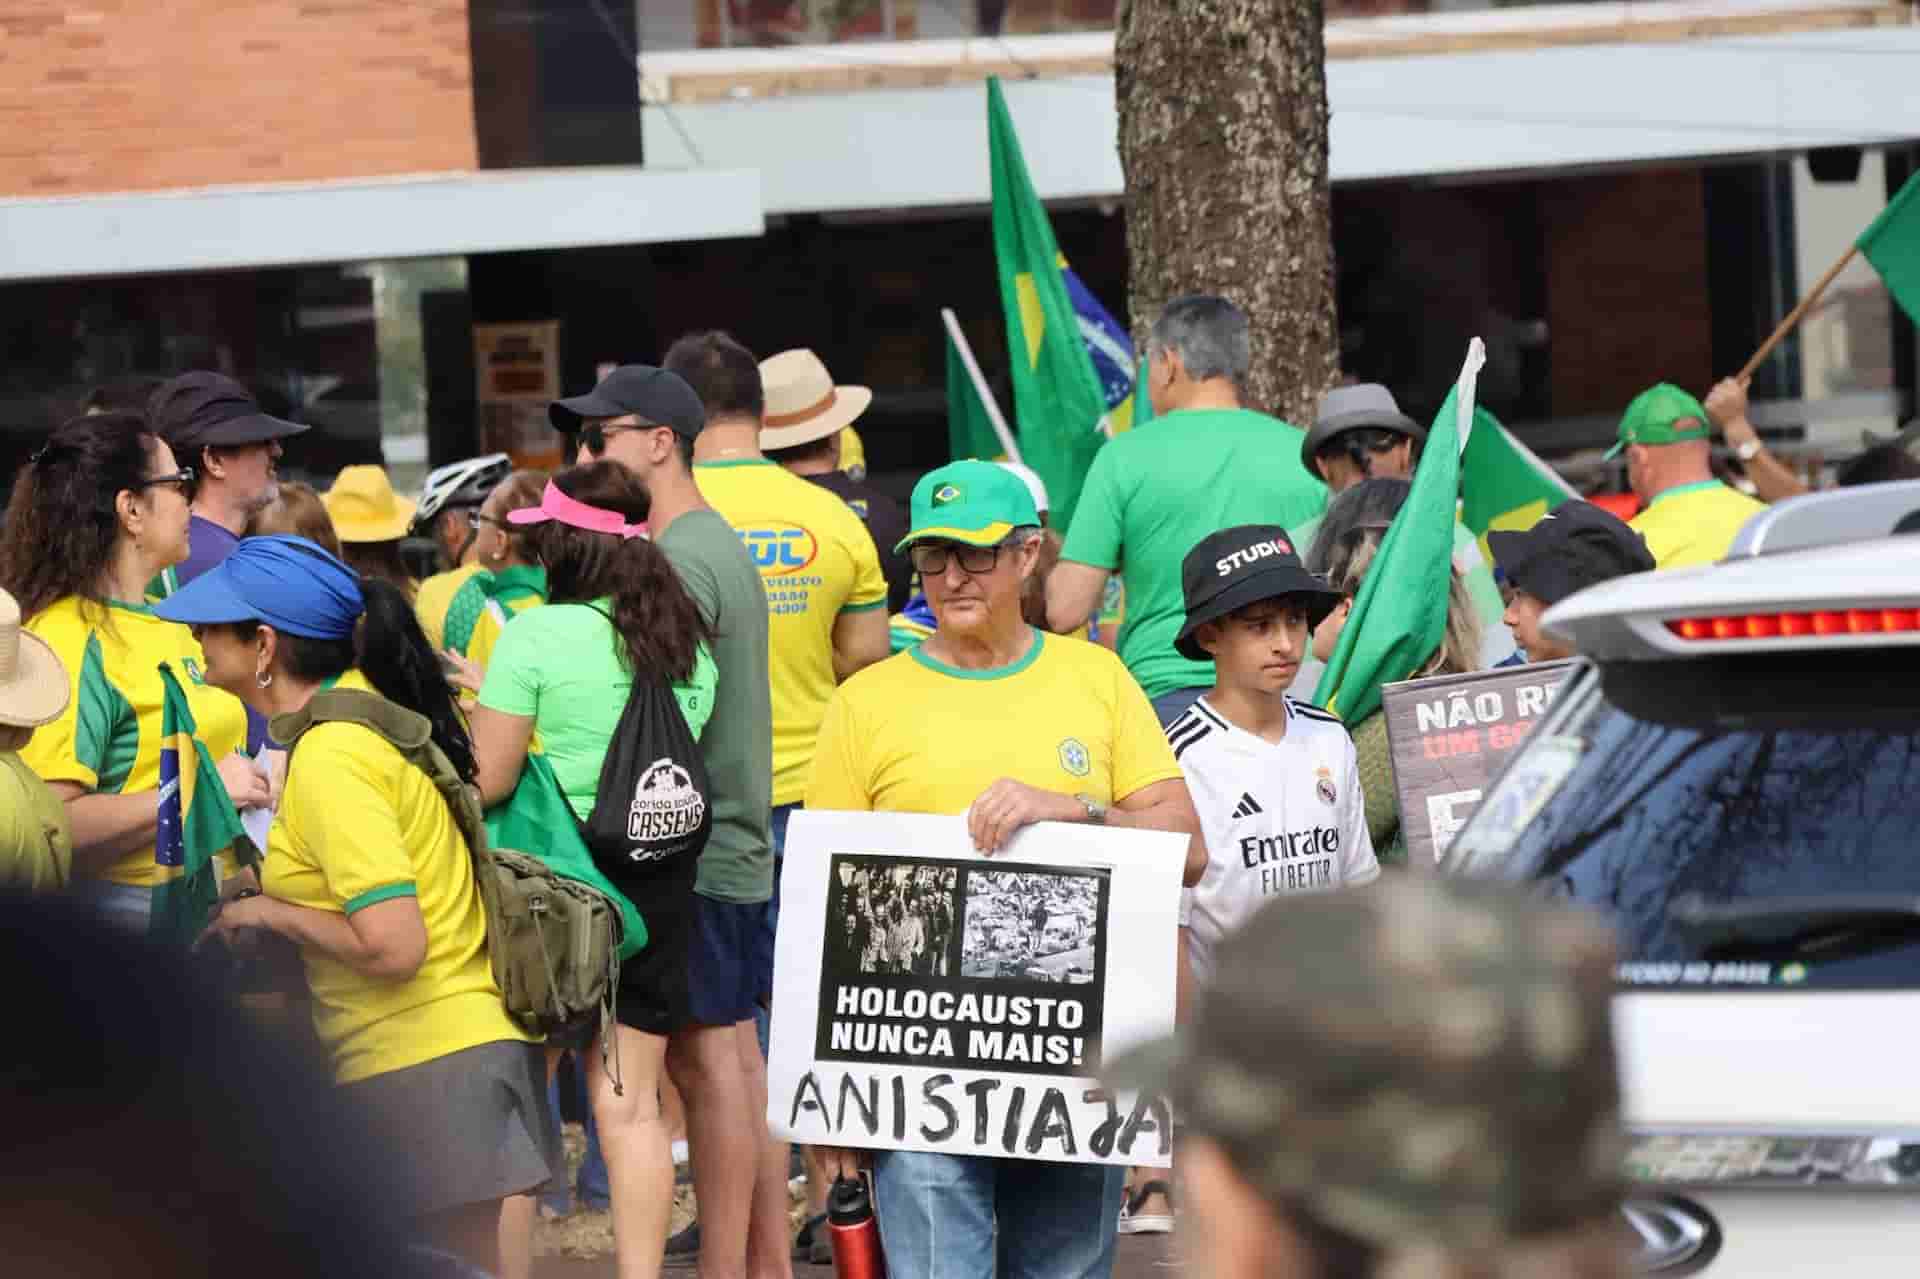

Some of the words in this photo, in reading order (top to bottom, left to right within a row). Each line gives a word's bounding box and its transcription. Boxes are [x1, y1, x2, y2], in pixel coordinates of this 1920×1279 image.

[1415, 690, 1504, 732] NÃO
[1423, 731, 1480, 760] UM
[1239, 826, 1339, 869] Emirate
[835, 985, 1084, 1029] HOLOCAUSTO
[830, 1021, 955, 1058] NUNCA
[968, 1031, 1084, 1065] MAIS!
